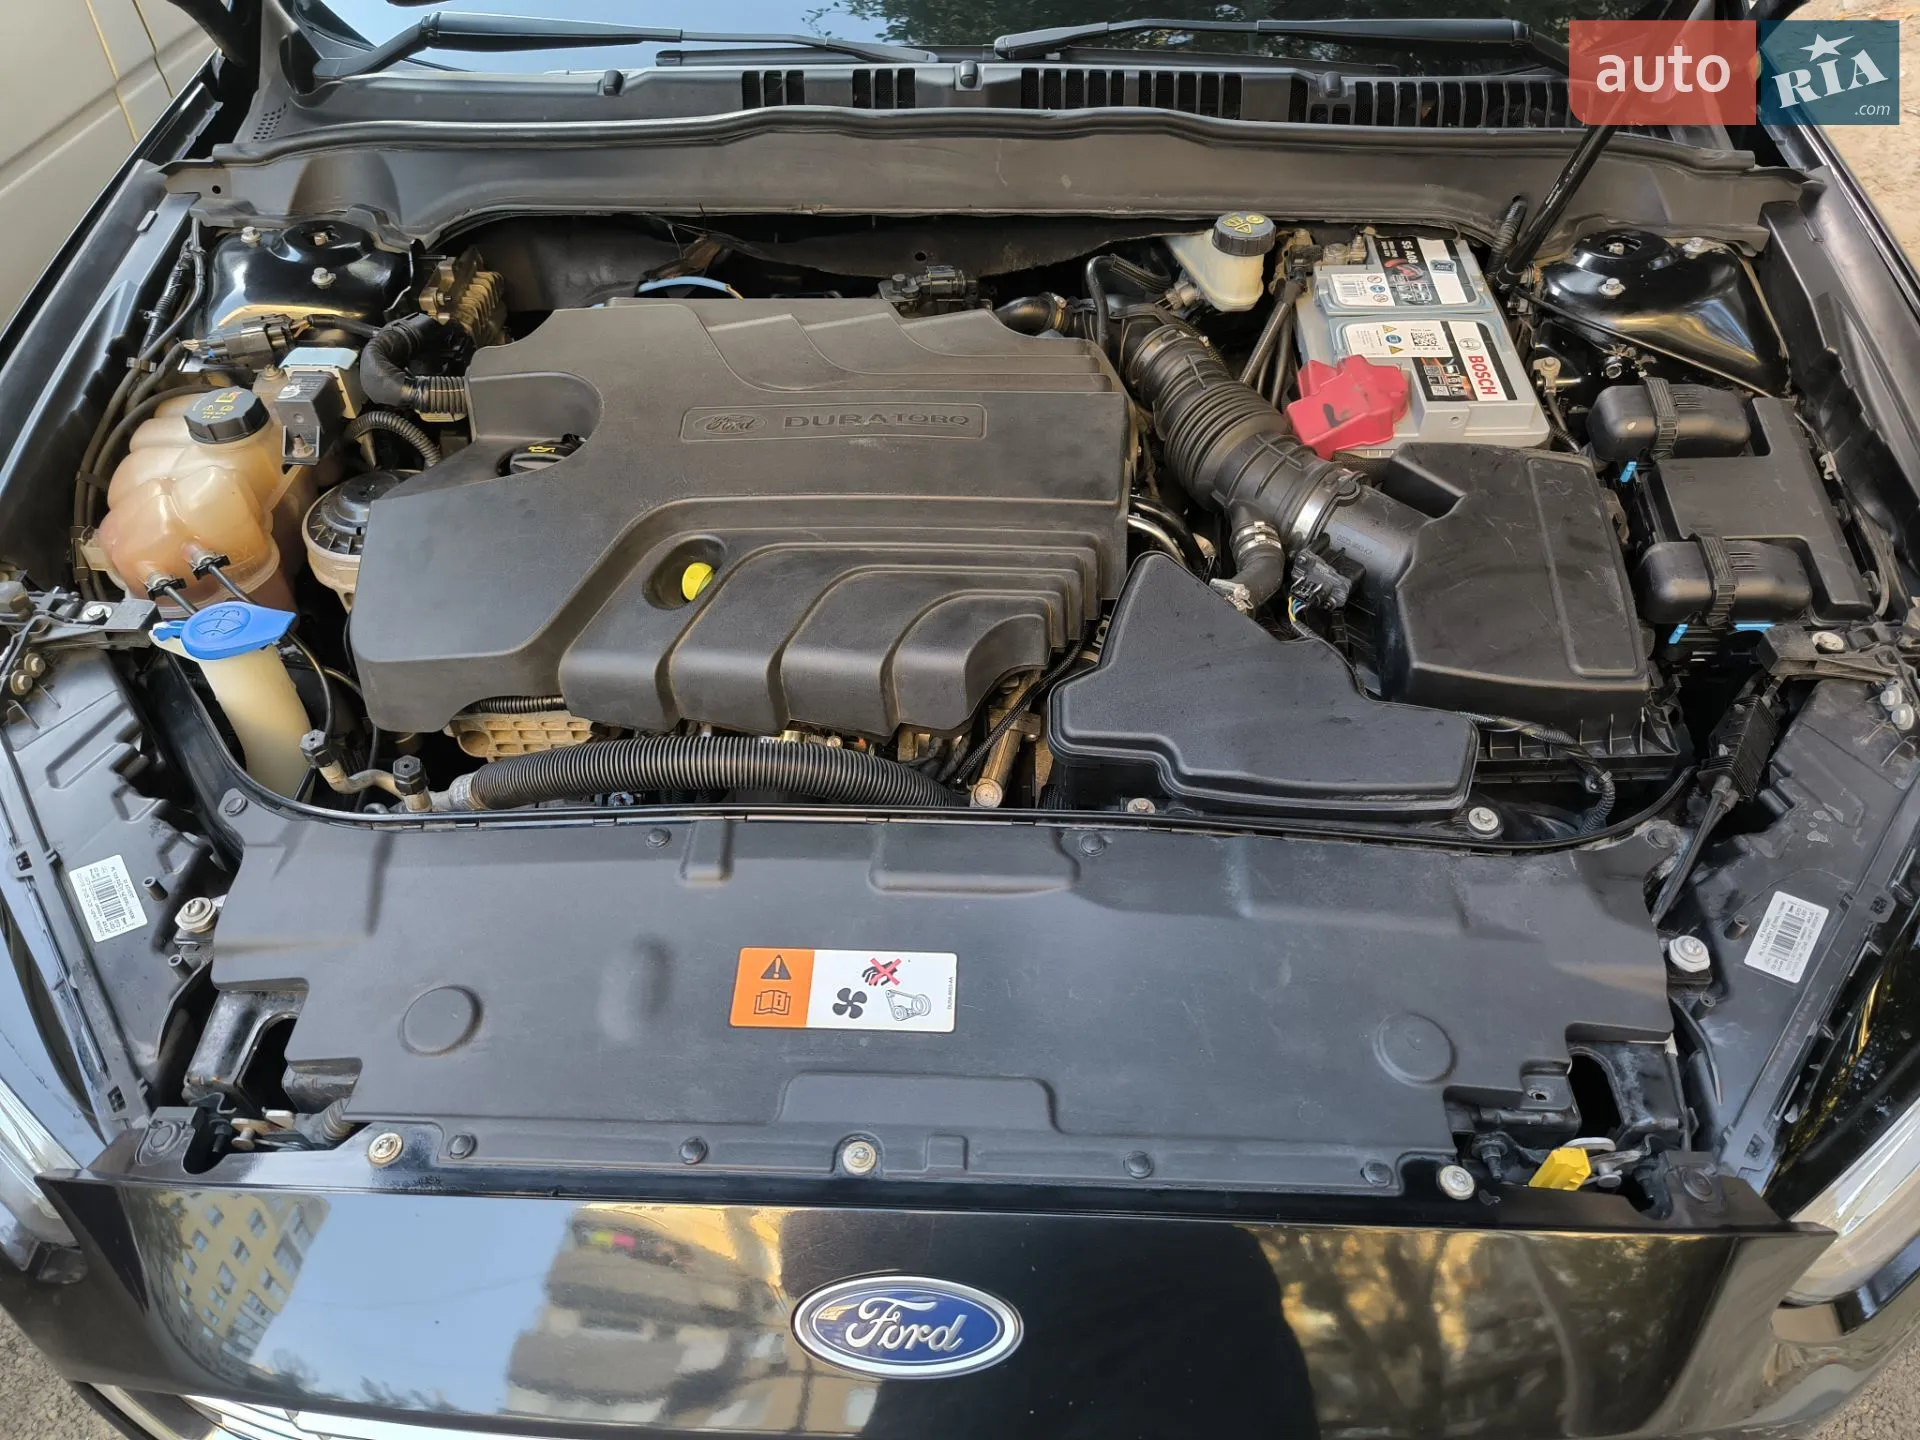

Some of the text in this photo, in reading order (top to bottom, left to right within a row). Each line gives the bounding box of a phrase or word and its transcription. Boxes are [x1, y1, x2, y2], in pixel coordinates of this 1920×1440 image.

[1467, 355, 1498, 395] BOSCH
[703, 413, 756, 435] Ford
[845, 1296, 968, 1351] Ford
